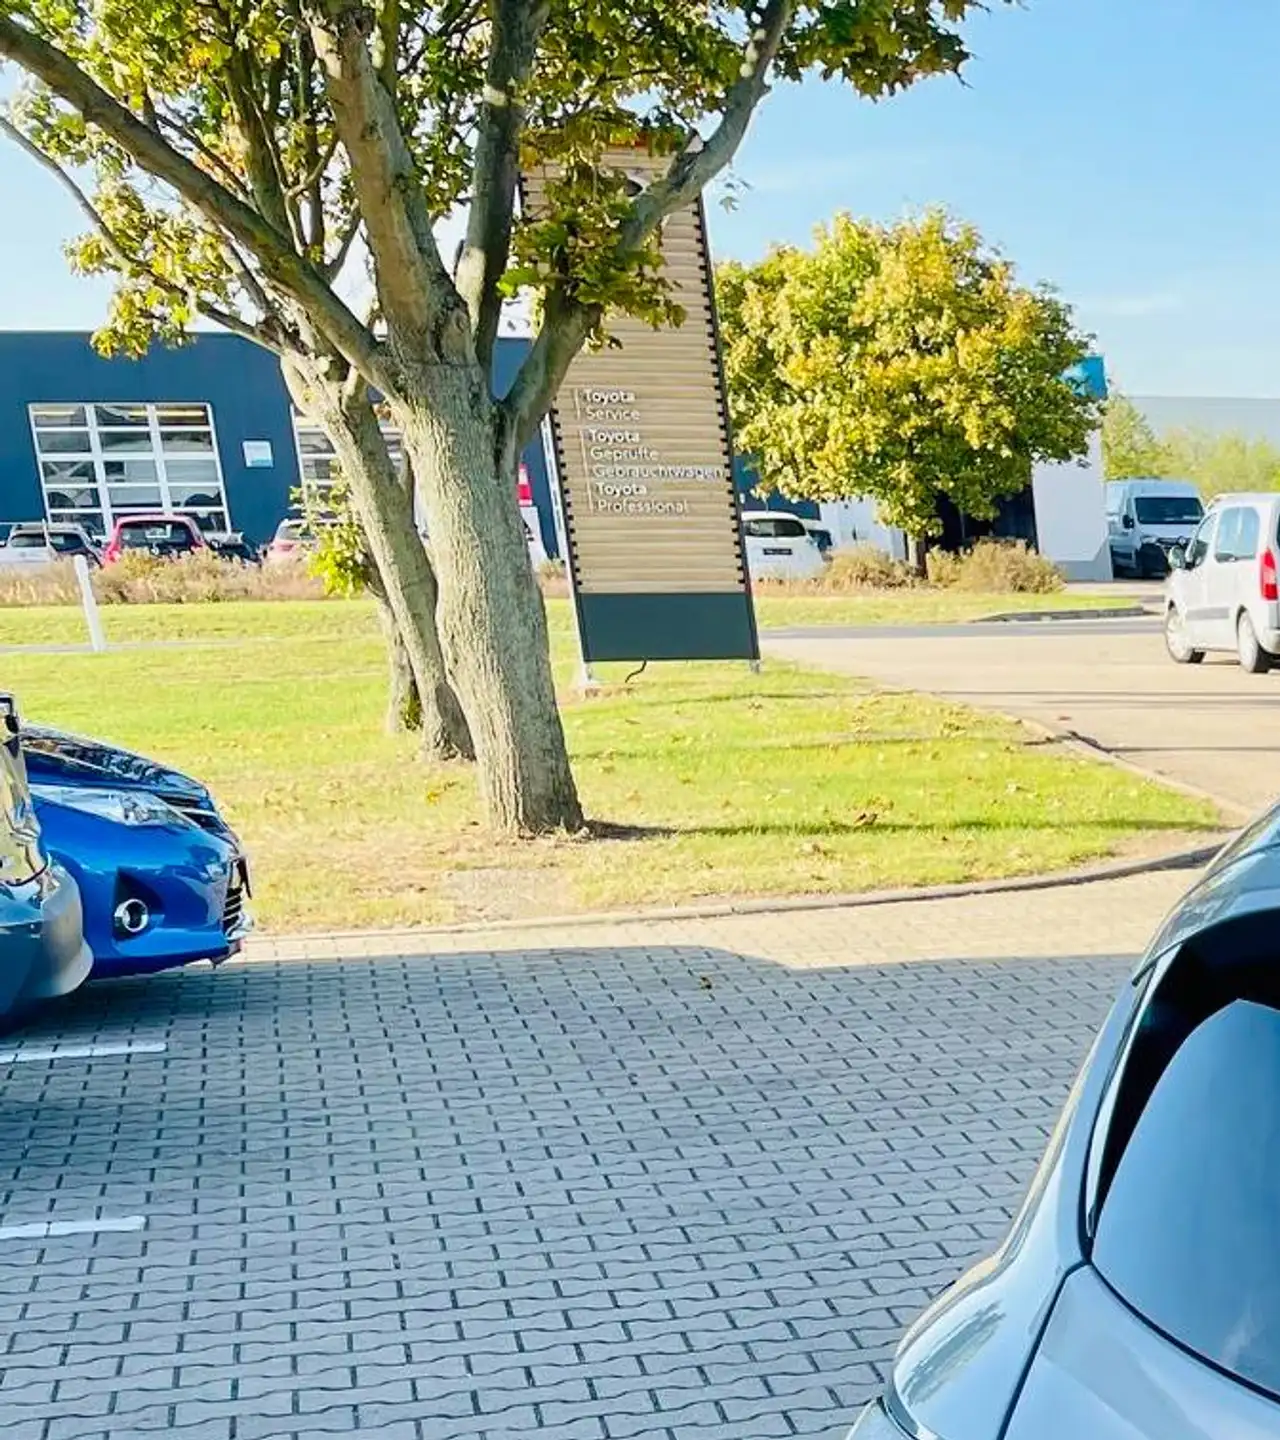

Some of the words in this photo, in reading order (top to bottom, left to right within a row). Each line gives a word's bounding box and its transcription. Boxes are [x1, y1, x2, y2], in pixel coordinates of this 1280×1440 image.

[583, 387, 636, 406] Toyota
[586, 407, 641, 421] Service
[589, 427, 640, 445] Toyota
[595, 482, 647, 500] Toyota
[598, 499, 689, 514] Professional
